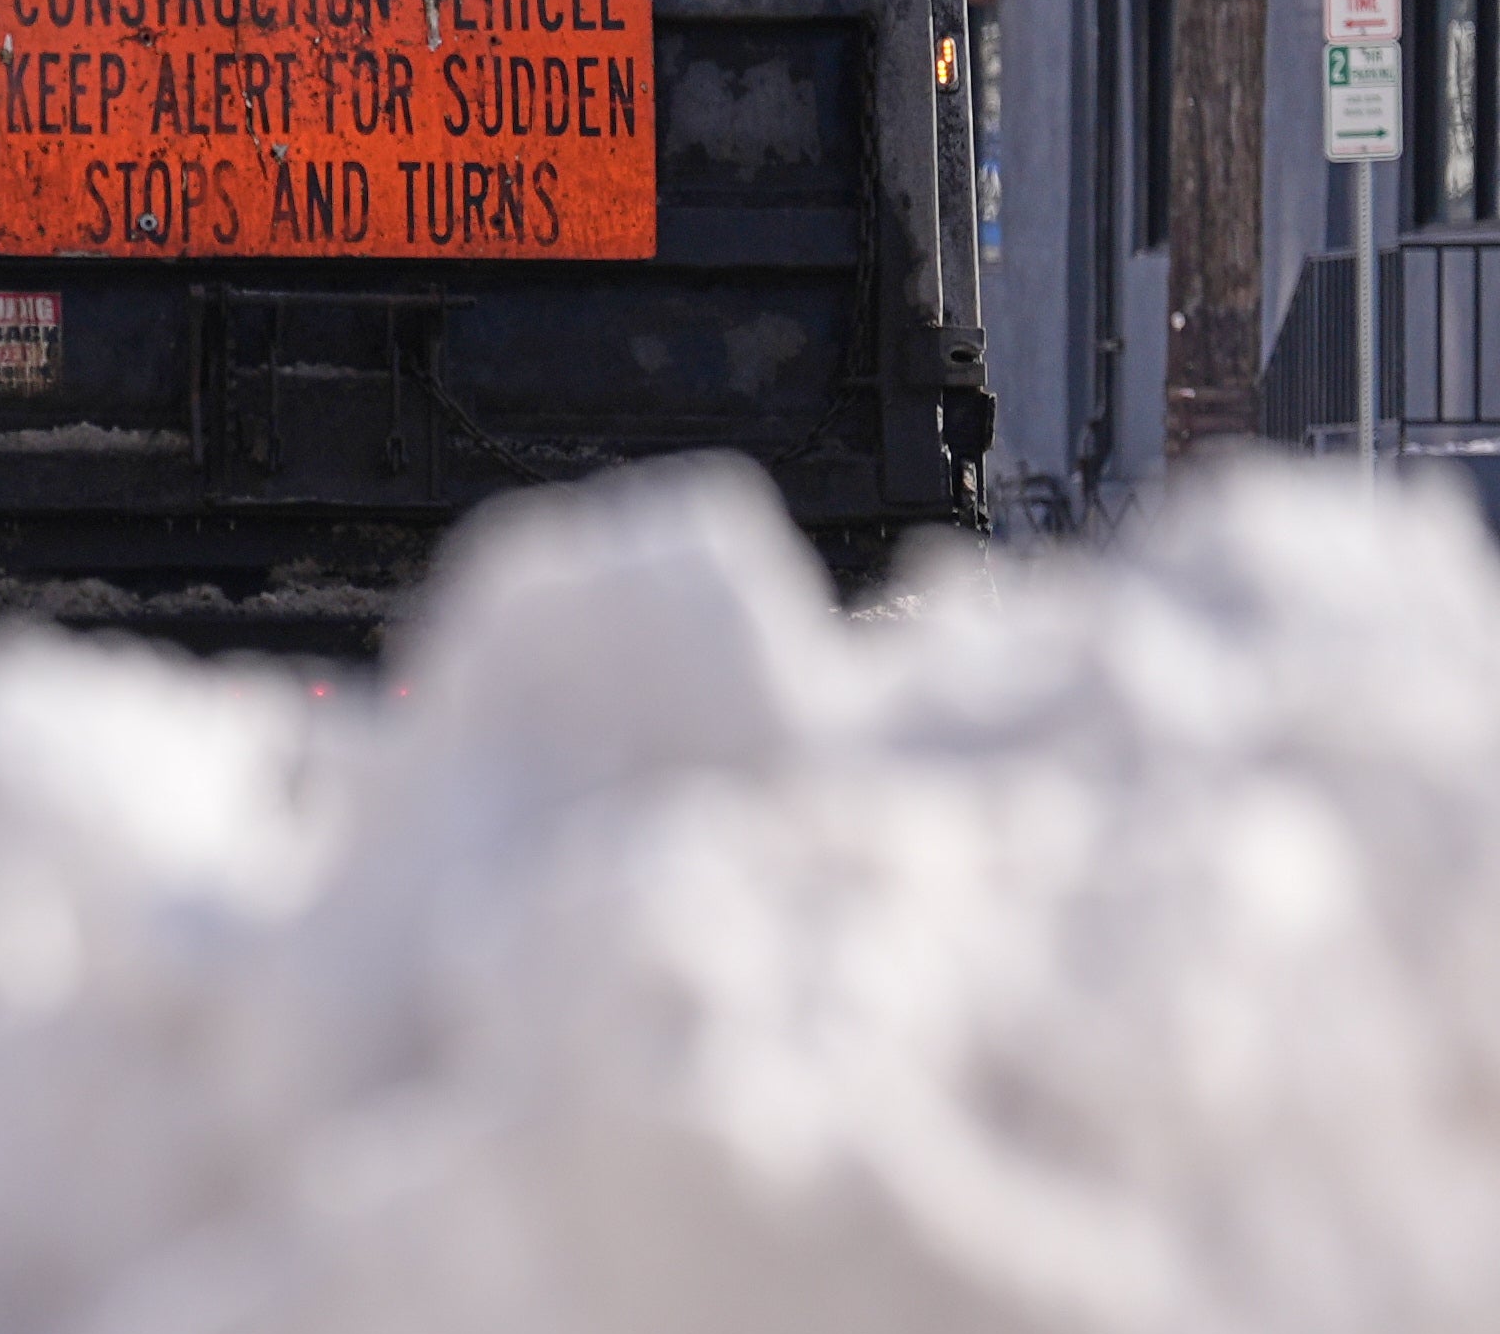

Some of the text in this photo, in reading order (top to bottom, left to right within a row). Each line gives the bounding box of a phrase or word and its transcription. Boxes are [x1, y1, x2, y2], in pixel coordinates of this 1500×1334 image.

[5, 51, 637, 138] KEEP ALERT FOR SUDDEN
[1331, 50, 1346, 83] 2
[85, 160, 560, 247] STOPS AND TURNS
